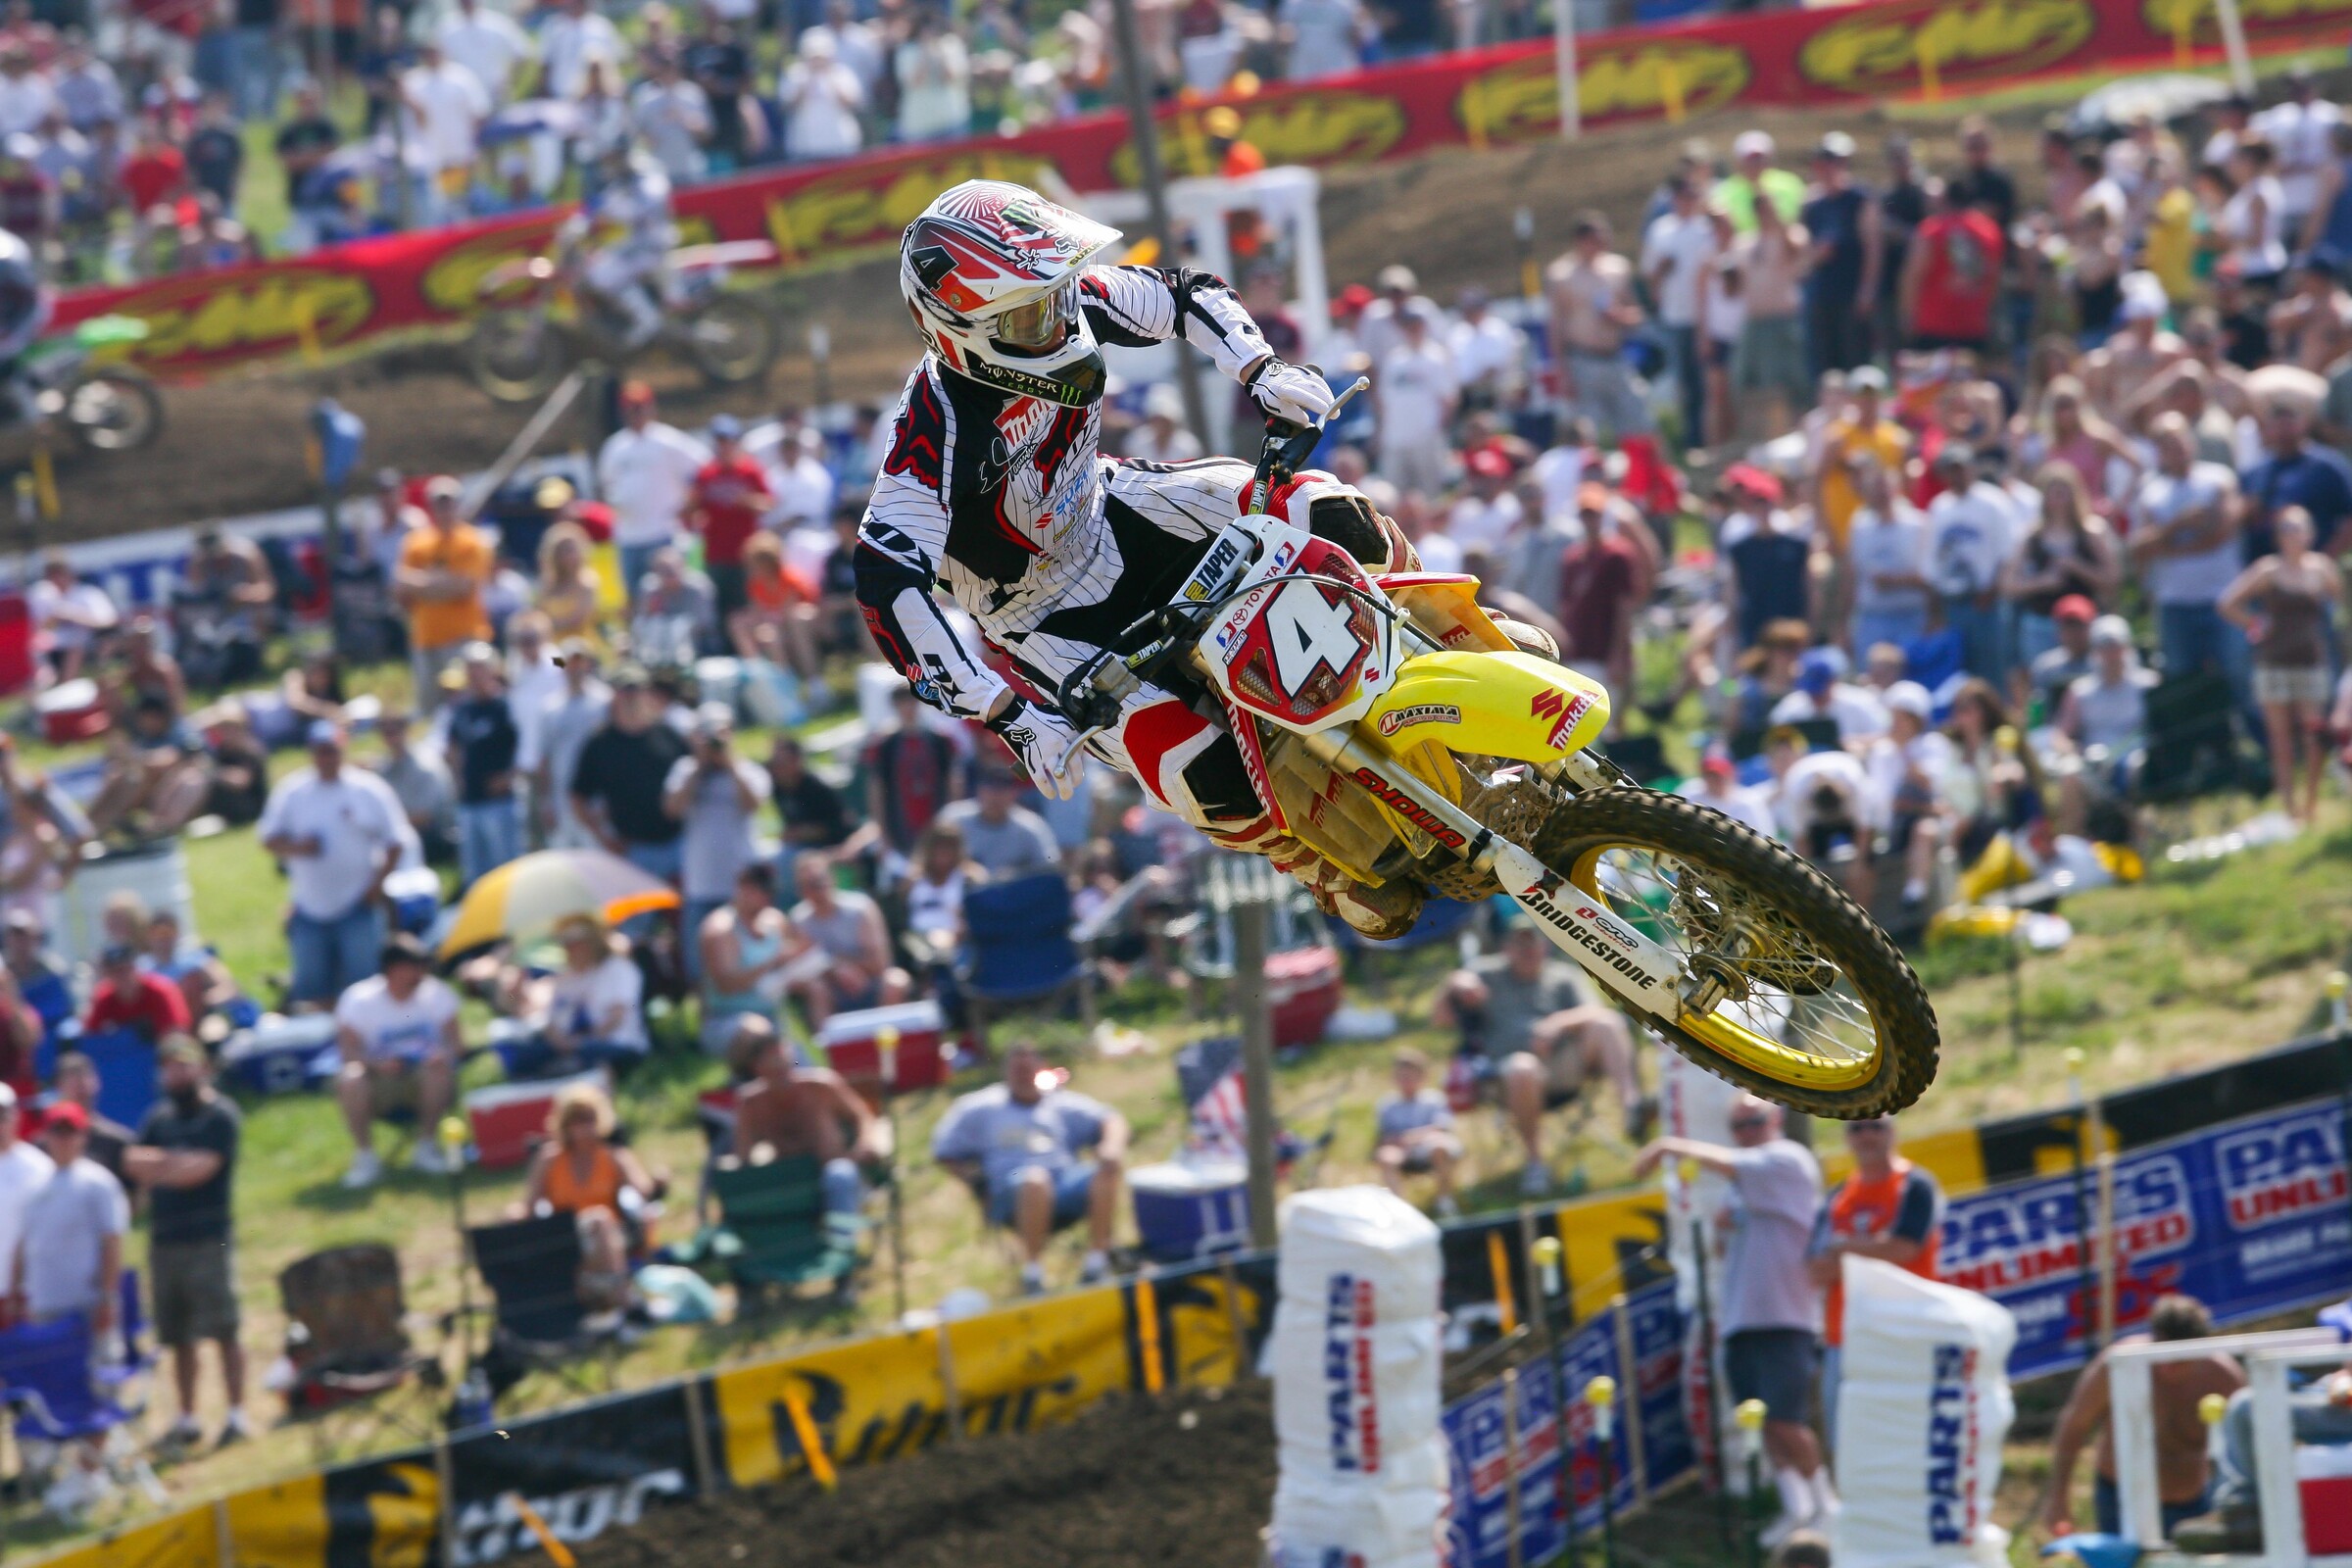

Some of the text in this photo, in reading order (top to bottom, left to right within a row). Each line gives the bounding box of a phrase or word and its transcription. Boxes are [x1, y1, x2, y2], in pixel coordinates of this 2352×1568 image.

[980, 362, 1057, 393] MONSTER
[1196, 538, 1240, 590] TAPER
[1137, 641, 1161, 660] TAPER
[1265, 564, 1362, 698] 4
[1396, 707, 1458, 723] MAXIMA
[1227, 702, 1271, 815] makita
[1348, 767, 1467, 849] SHOWA
[1517, 886, 1657, 990] BRIDGESTONE
[1929, 1344, 1961, 1544] PARTS
